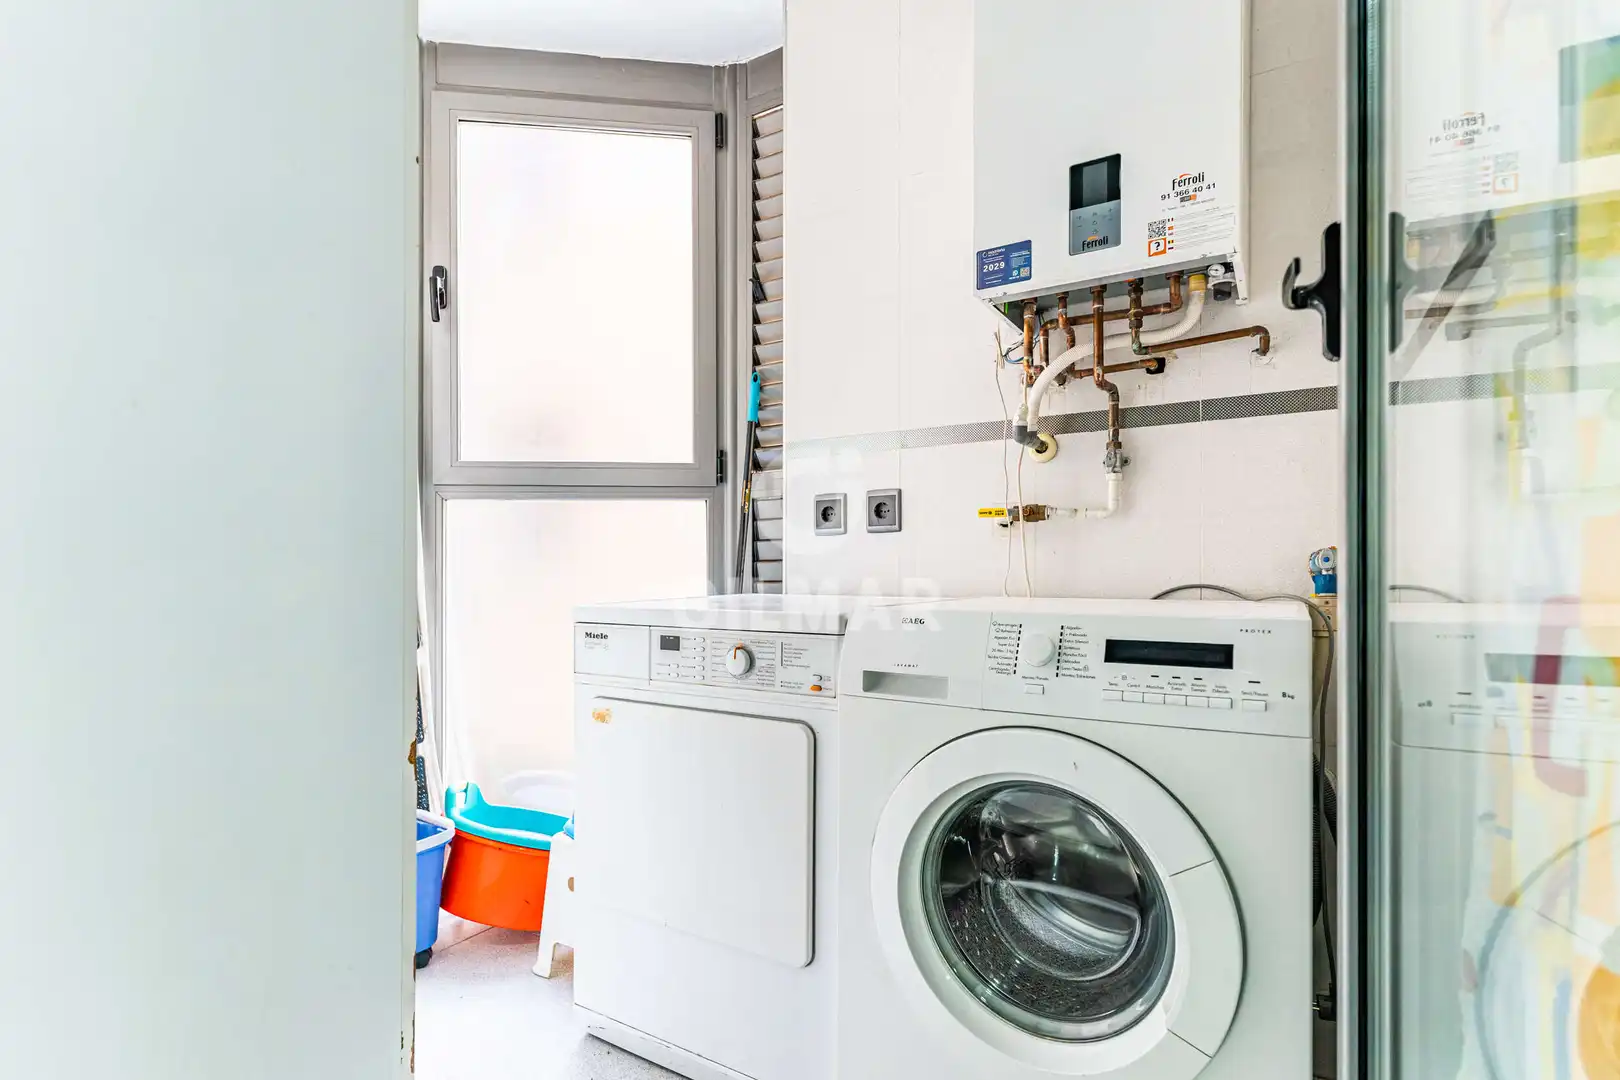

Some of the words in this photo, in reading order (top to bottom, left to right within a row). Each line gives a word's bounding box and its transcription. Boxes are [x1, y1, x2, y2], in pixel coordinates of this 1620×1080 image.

[1172, 172, 1205, 191] Ferroli
[1161, 193, 1171, 201] 91
[1174, 189, 1190, 198] 366
[1082, 236, 1109, 251] Ferroli
[983, 261, 1005, 273] 2029
[908, 617, 926, 625] AEG
[585, 632, 609, 640] Miele
